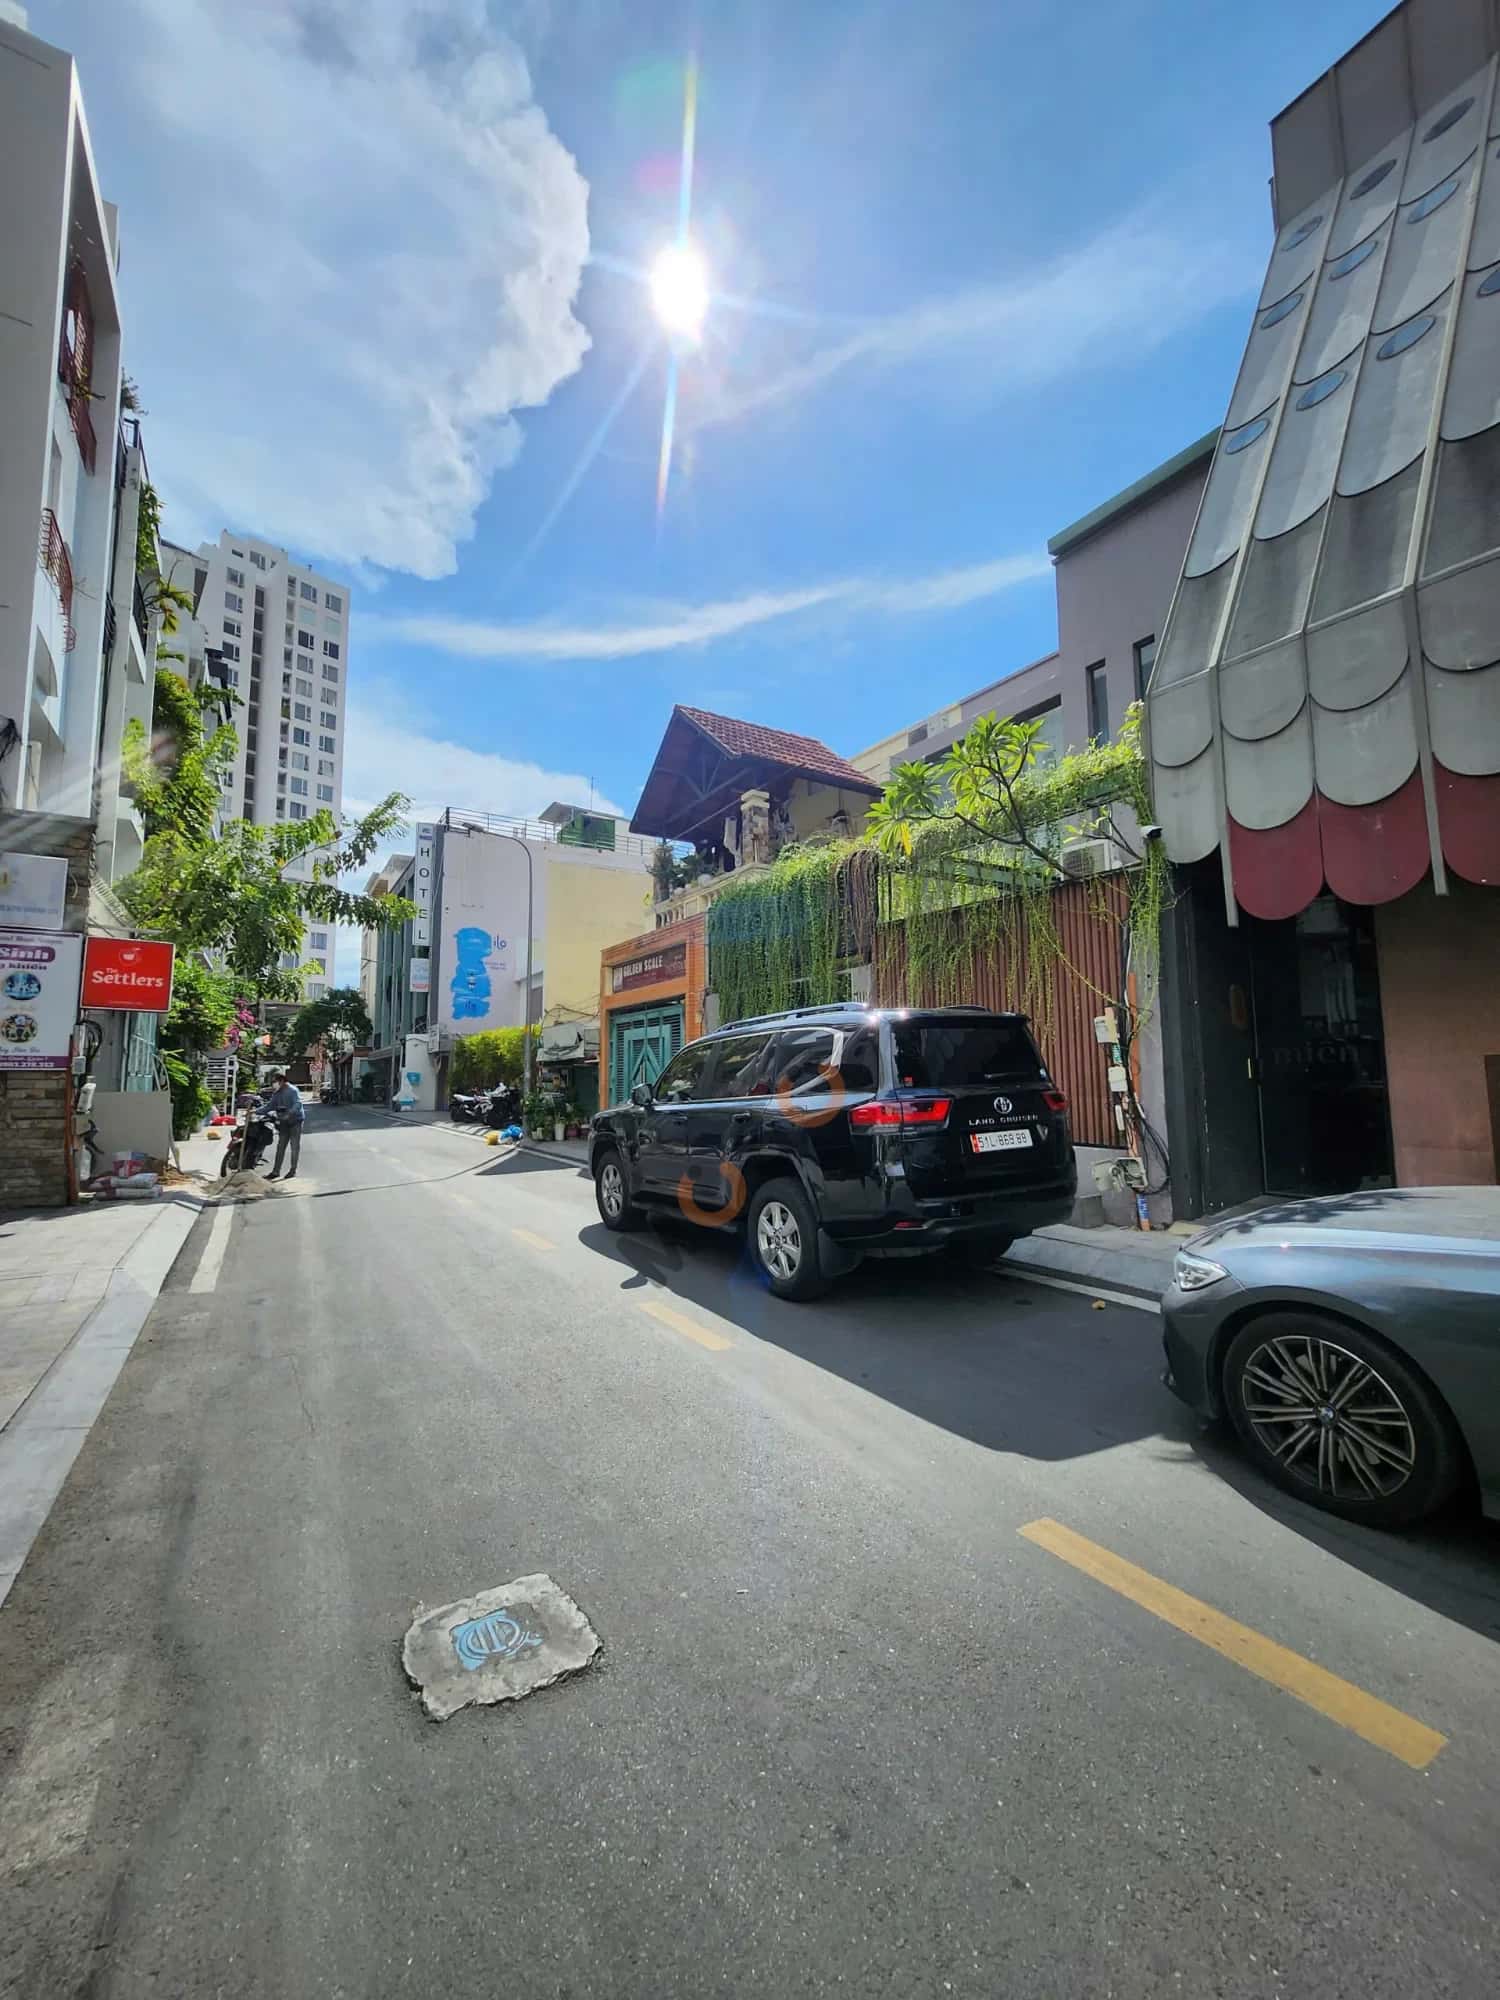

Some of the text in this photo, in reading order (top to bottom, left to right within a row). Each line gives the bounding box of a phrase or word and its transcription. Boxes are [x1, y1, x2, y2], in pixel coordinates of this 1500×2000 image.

[418, 847, 430, 941] HOTEL
[644, 955, 663, 971] SCALE
[91, 970, 165, 988] Settlers
[968, 1114, 1038, 1126] LAND CRUISER
